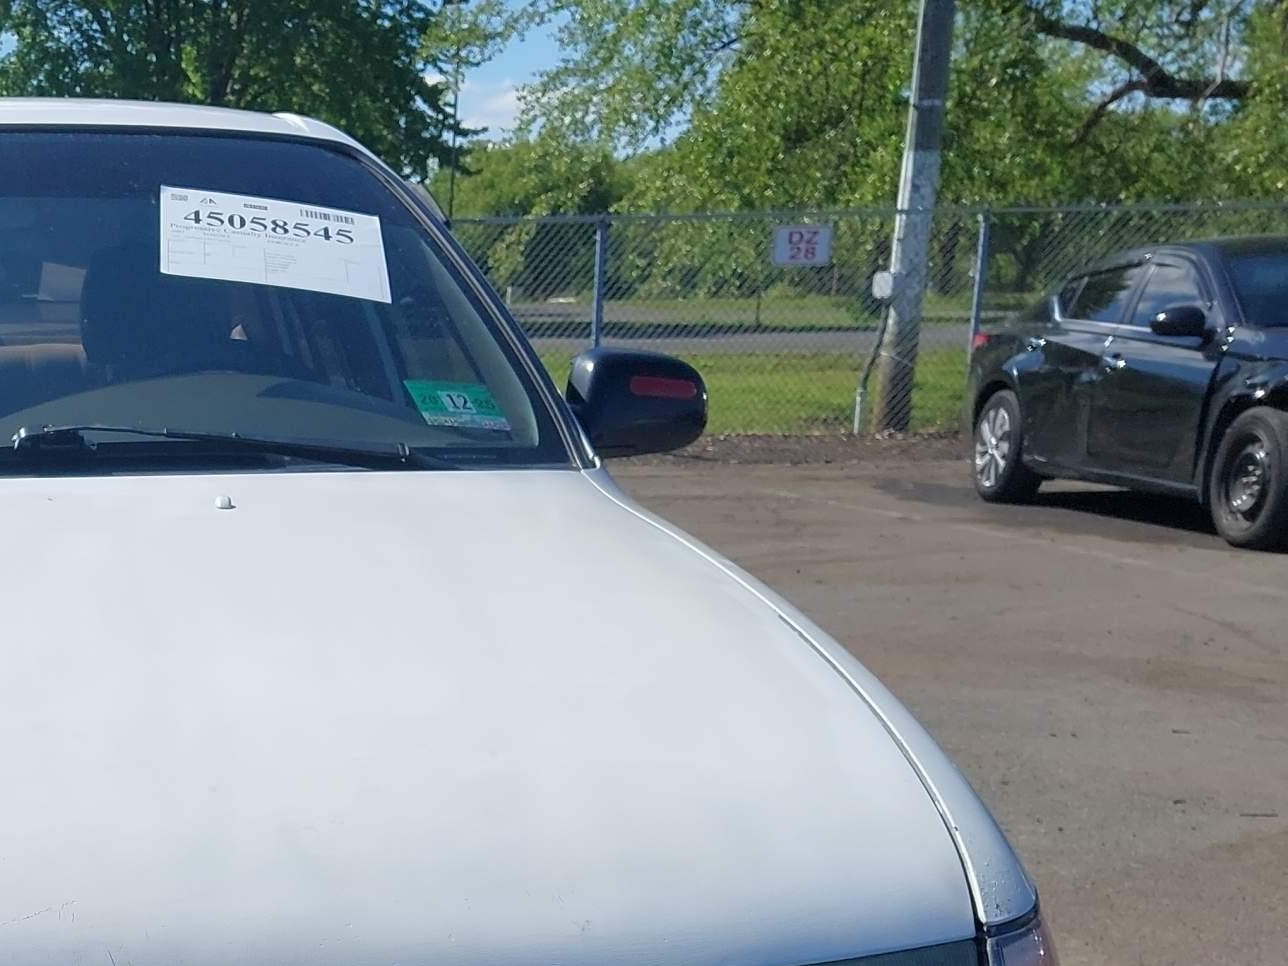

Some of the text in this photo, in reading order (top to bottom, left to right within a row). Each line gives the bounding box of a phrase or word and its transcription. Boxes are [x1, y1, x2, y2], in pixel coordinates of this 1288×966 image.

[183, 209, 354, 244] 45058545
[788, 230, 819, 245] DZ
[789, 246, 816, 260] 28
[446, 393, 472, 410] 12
